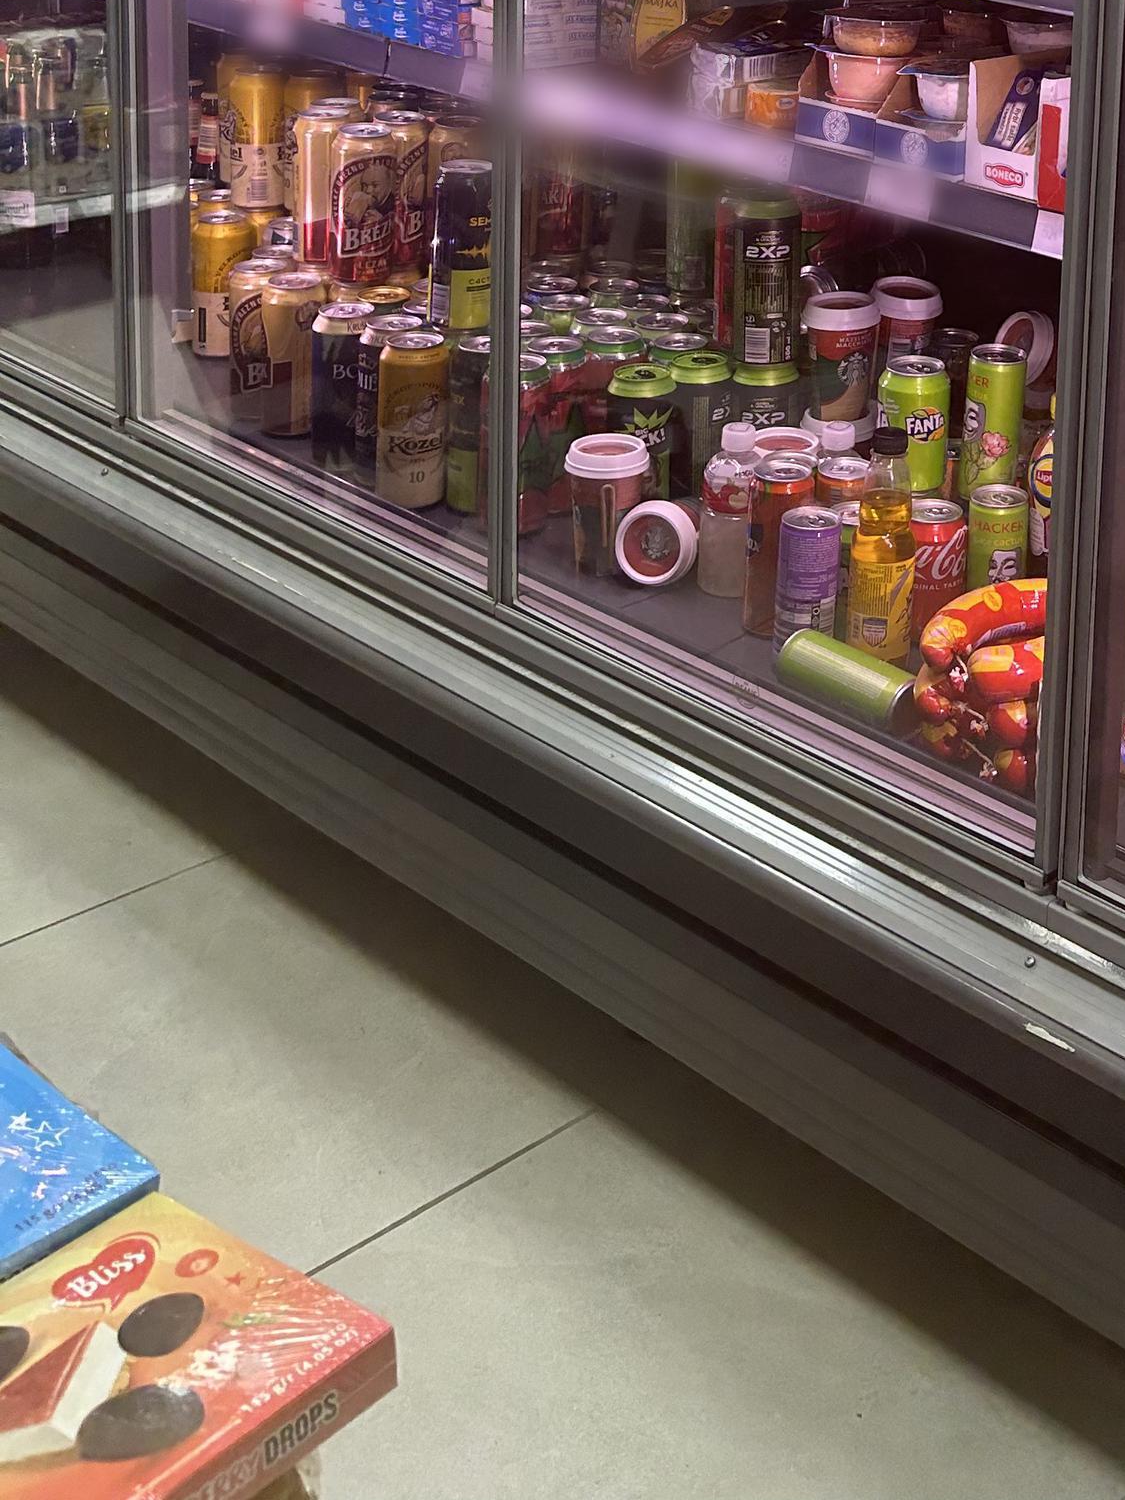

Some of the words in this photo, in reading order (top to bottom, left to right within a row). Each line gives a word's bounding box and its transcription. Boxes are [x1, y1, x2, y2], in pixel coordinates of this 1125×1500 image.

[986, 165, 1022, 183] BONECO
[906, 415, 944, 435] FANTA
[388, 434, 443, 455] Kozel
[409, 471, 425, 484] 10
[974, 519, 1024, 533] HACKER
[67, 1249, 146, 1298] Bliss
[264, 1392, 338, 1466] DROPS
